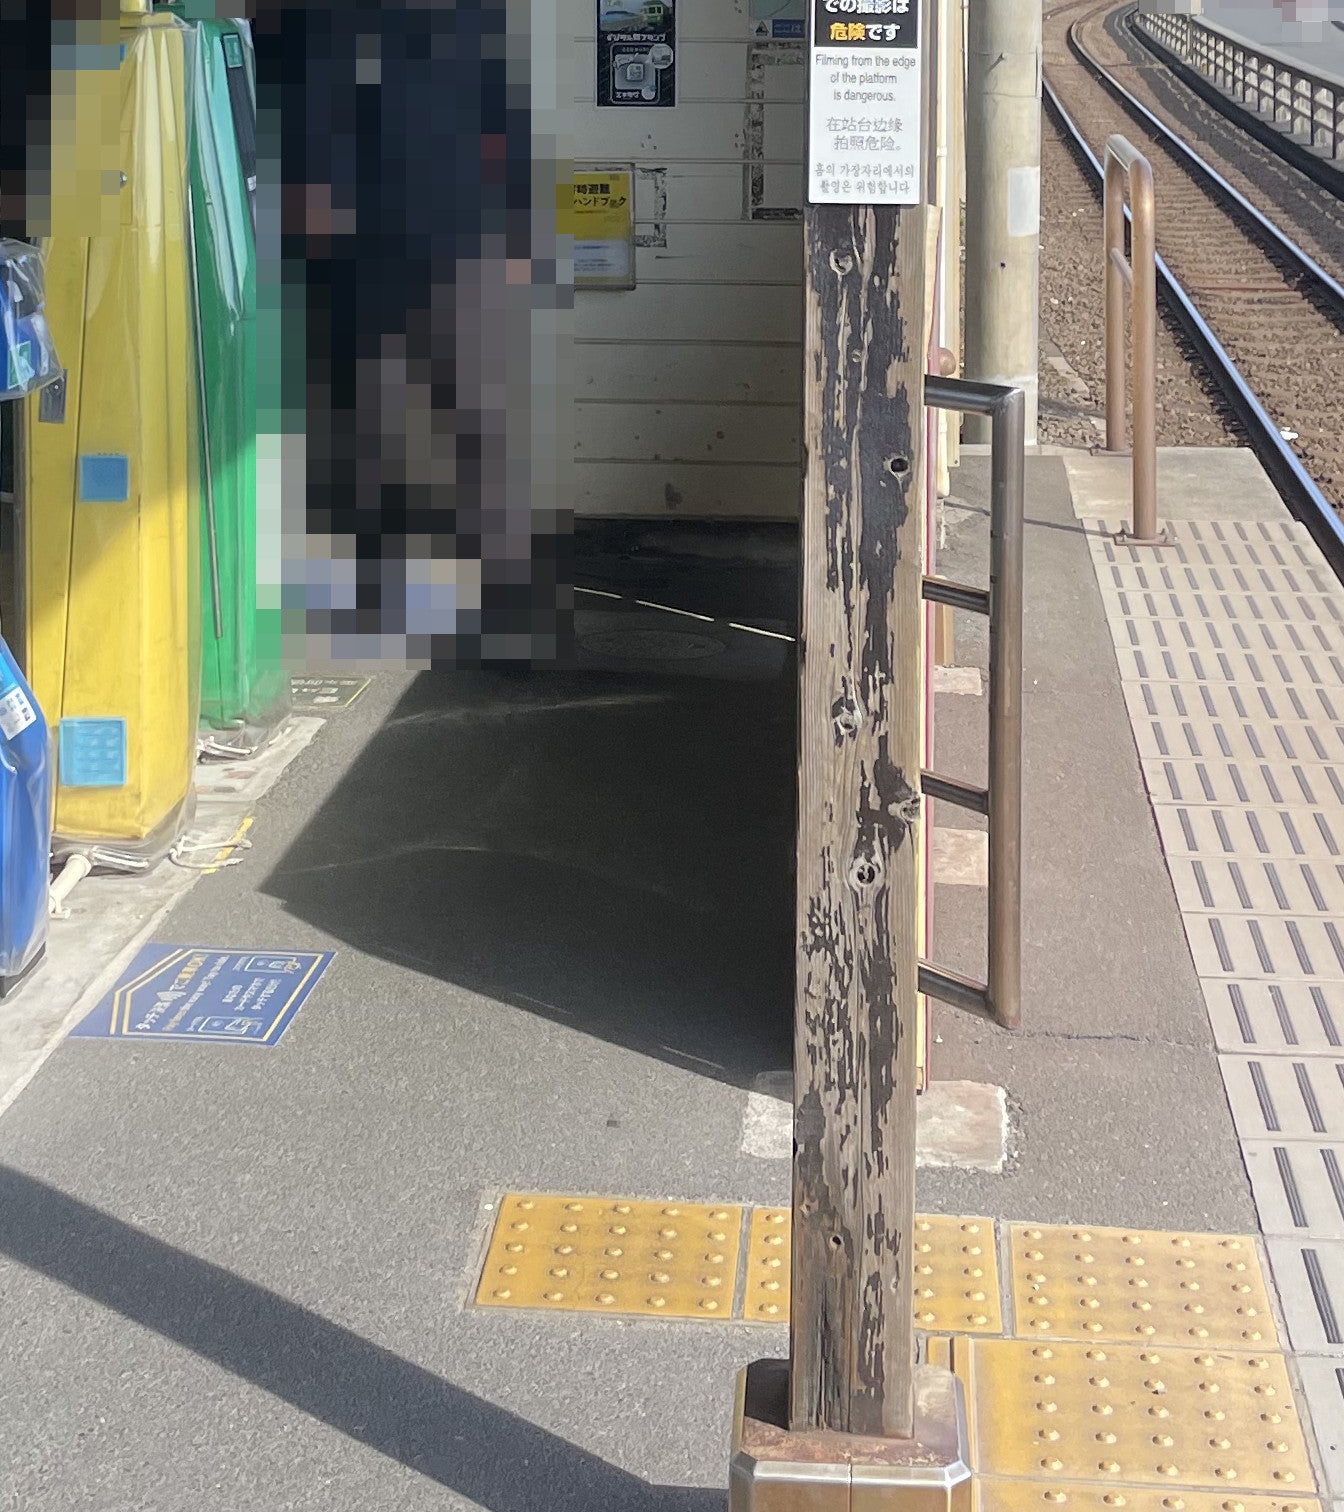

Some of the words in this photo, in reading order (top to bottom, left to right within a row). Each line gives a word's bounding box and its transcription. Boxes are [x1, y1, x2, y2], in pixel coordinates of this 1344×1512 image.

[829, 22, 900, 41] 危険です
[815, 54, 849, 68] Filming
[851, 54, 873, 66] from
[875, 55, 890, 66] the
[892, 55, 916, 69] edge
[830, 72, 840, 83] of
[842, 72, 857, 84] the
[859, 72, 897, 86] platform
[833, 90, 842, 101] is
[844, 90, 896, 104] dangerous.
[826, 117, 903, 133] 在站台边缘
